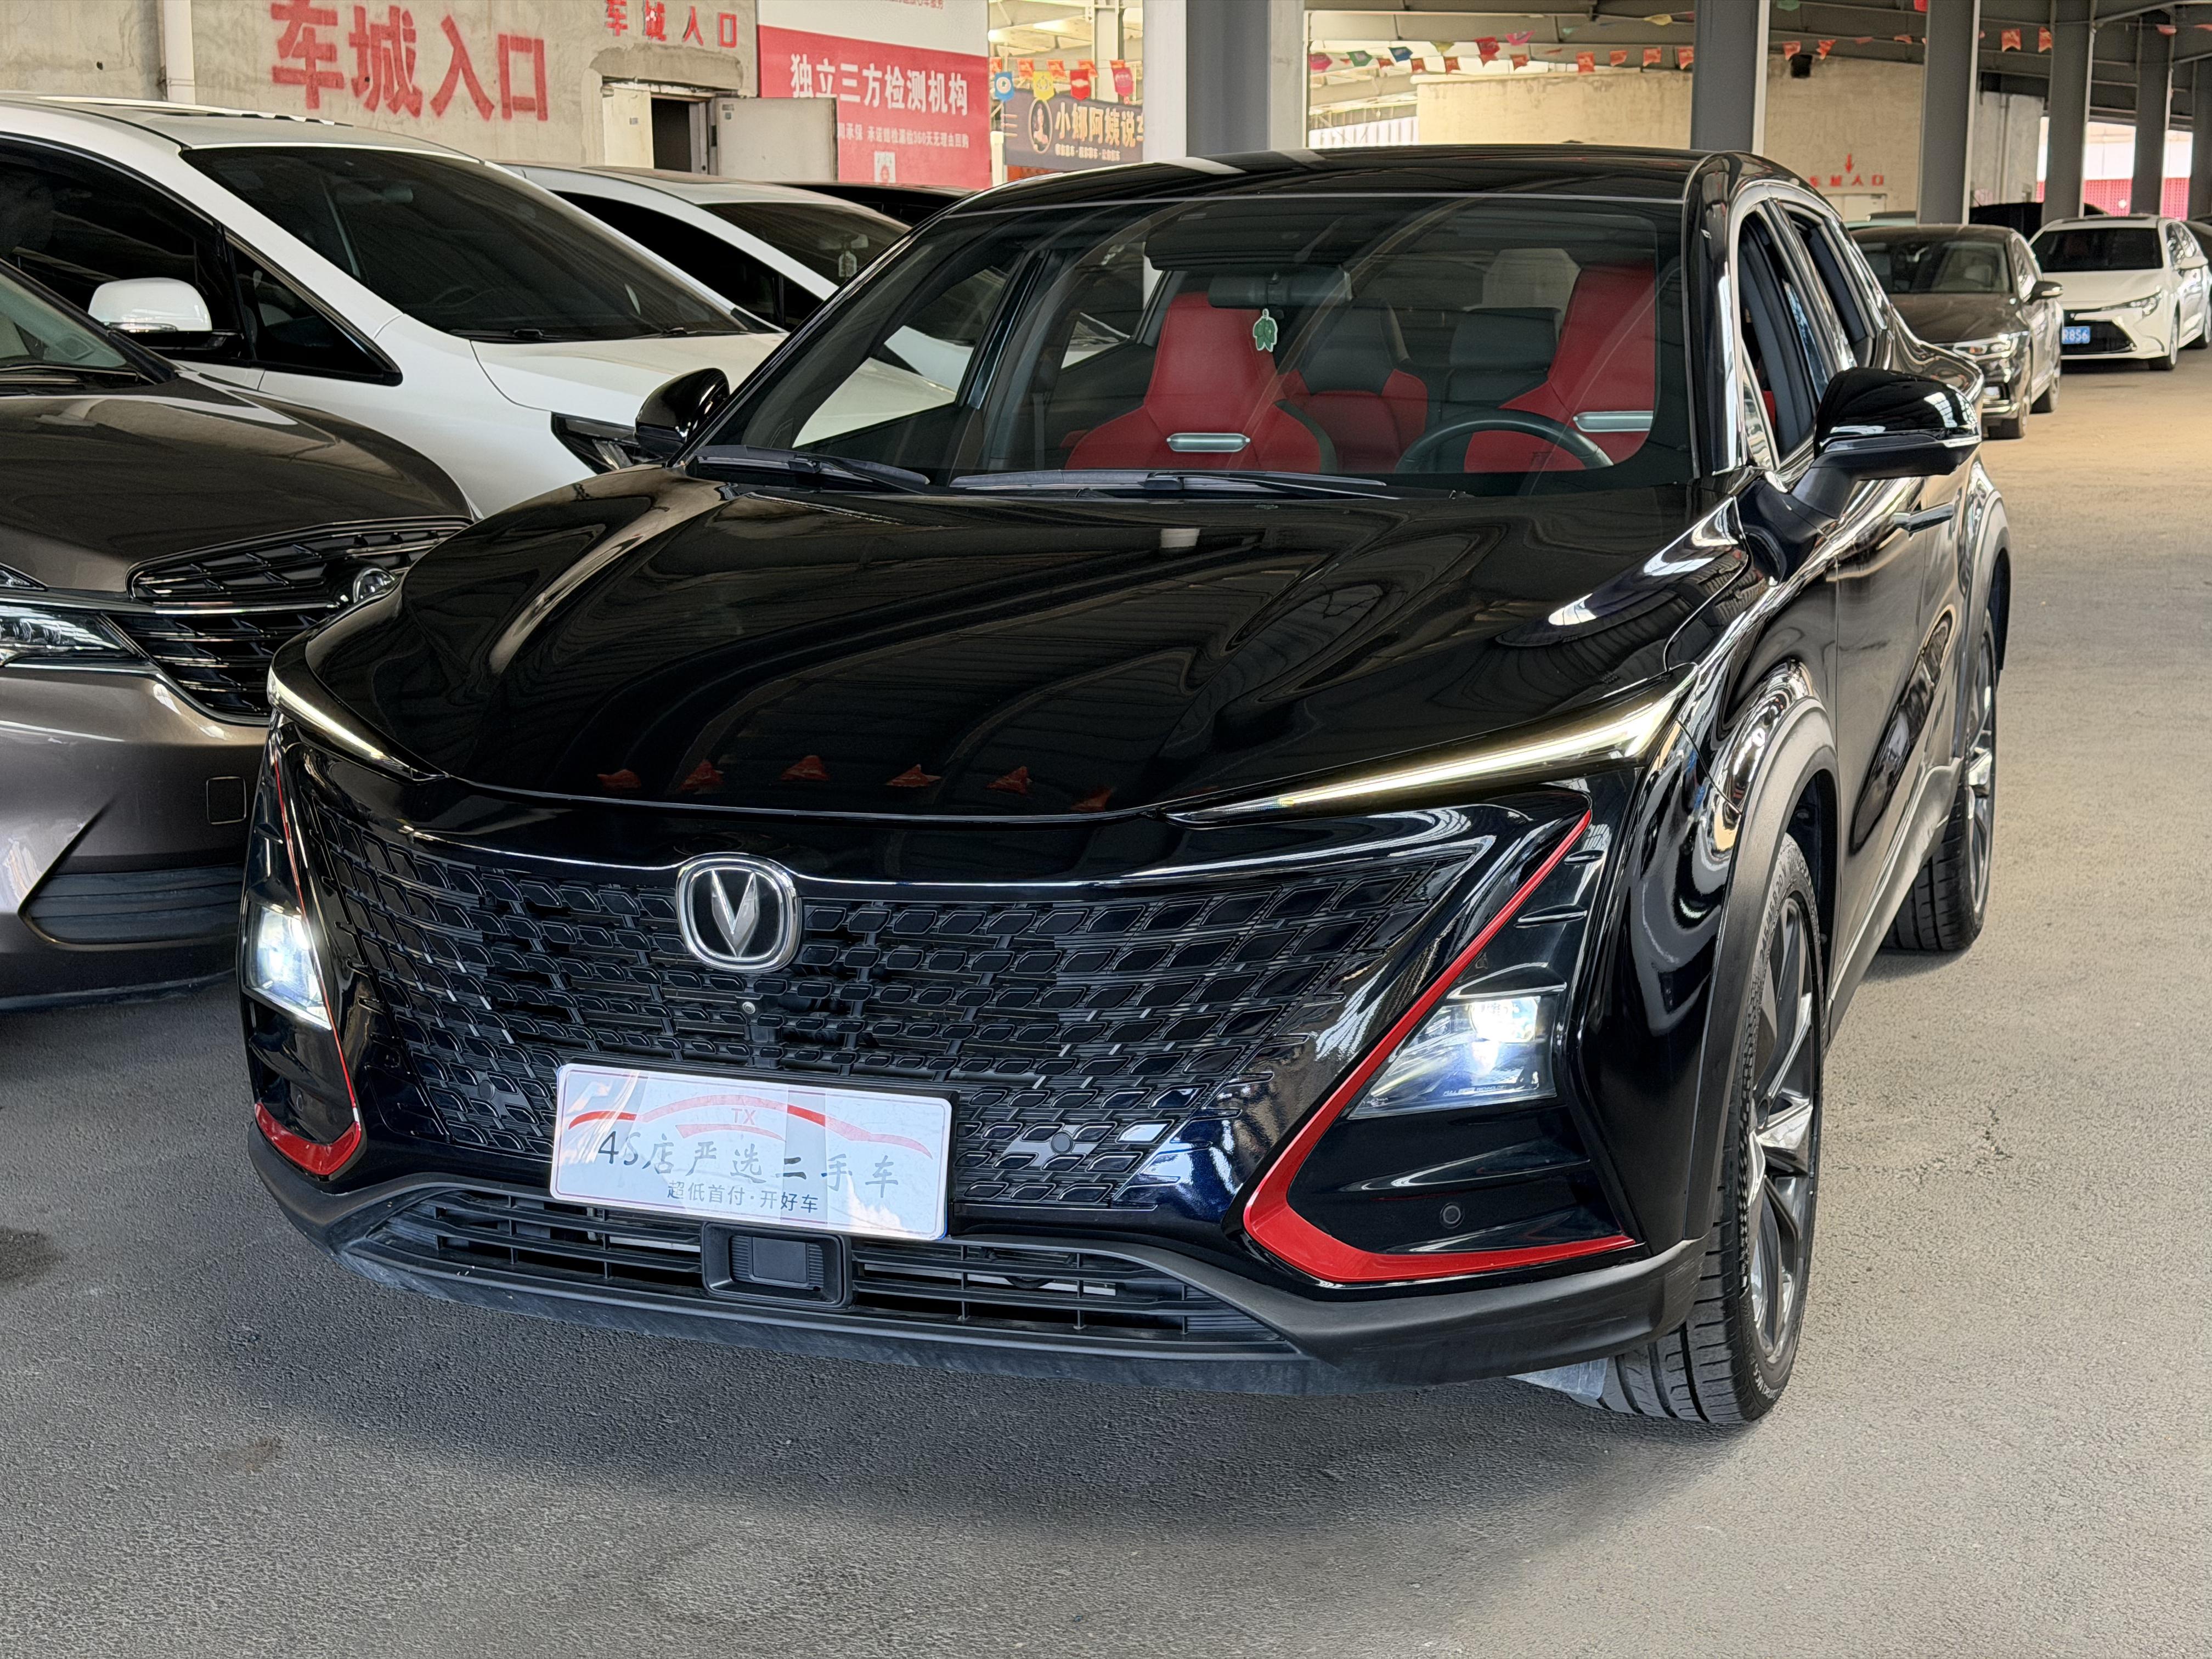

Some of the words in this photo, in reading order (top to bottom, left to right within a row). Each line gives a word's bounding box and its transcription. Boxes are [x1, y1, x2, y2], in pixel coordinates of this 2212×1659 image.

[606, 0, 737, 48] 车城入口
[270, 0, 549, 122] 车城入口
[790, 53, 968, 116] 独立三方检测机构
[731, 1109, 757, 1126] TX
[598, 1130, 899, 1198] 4S店严选二手车
